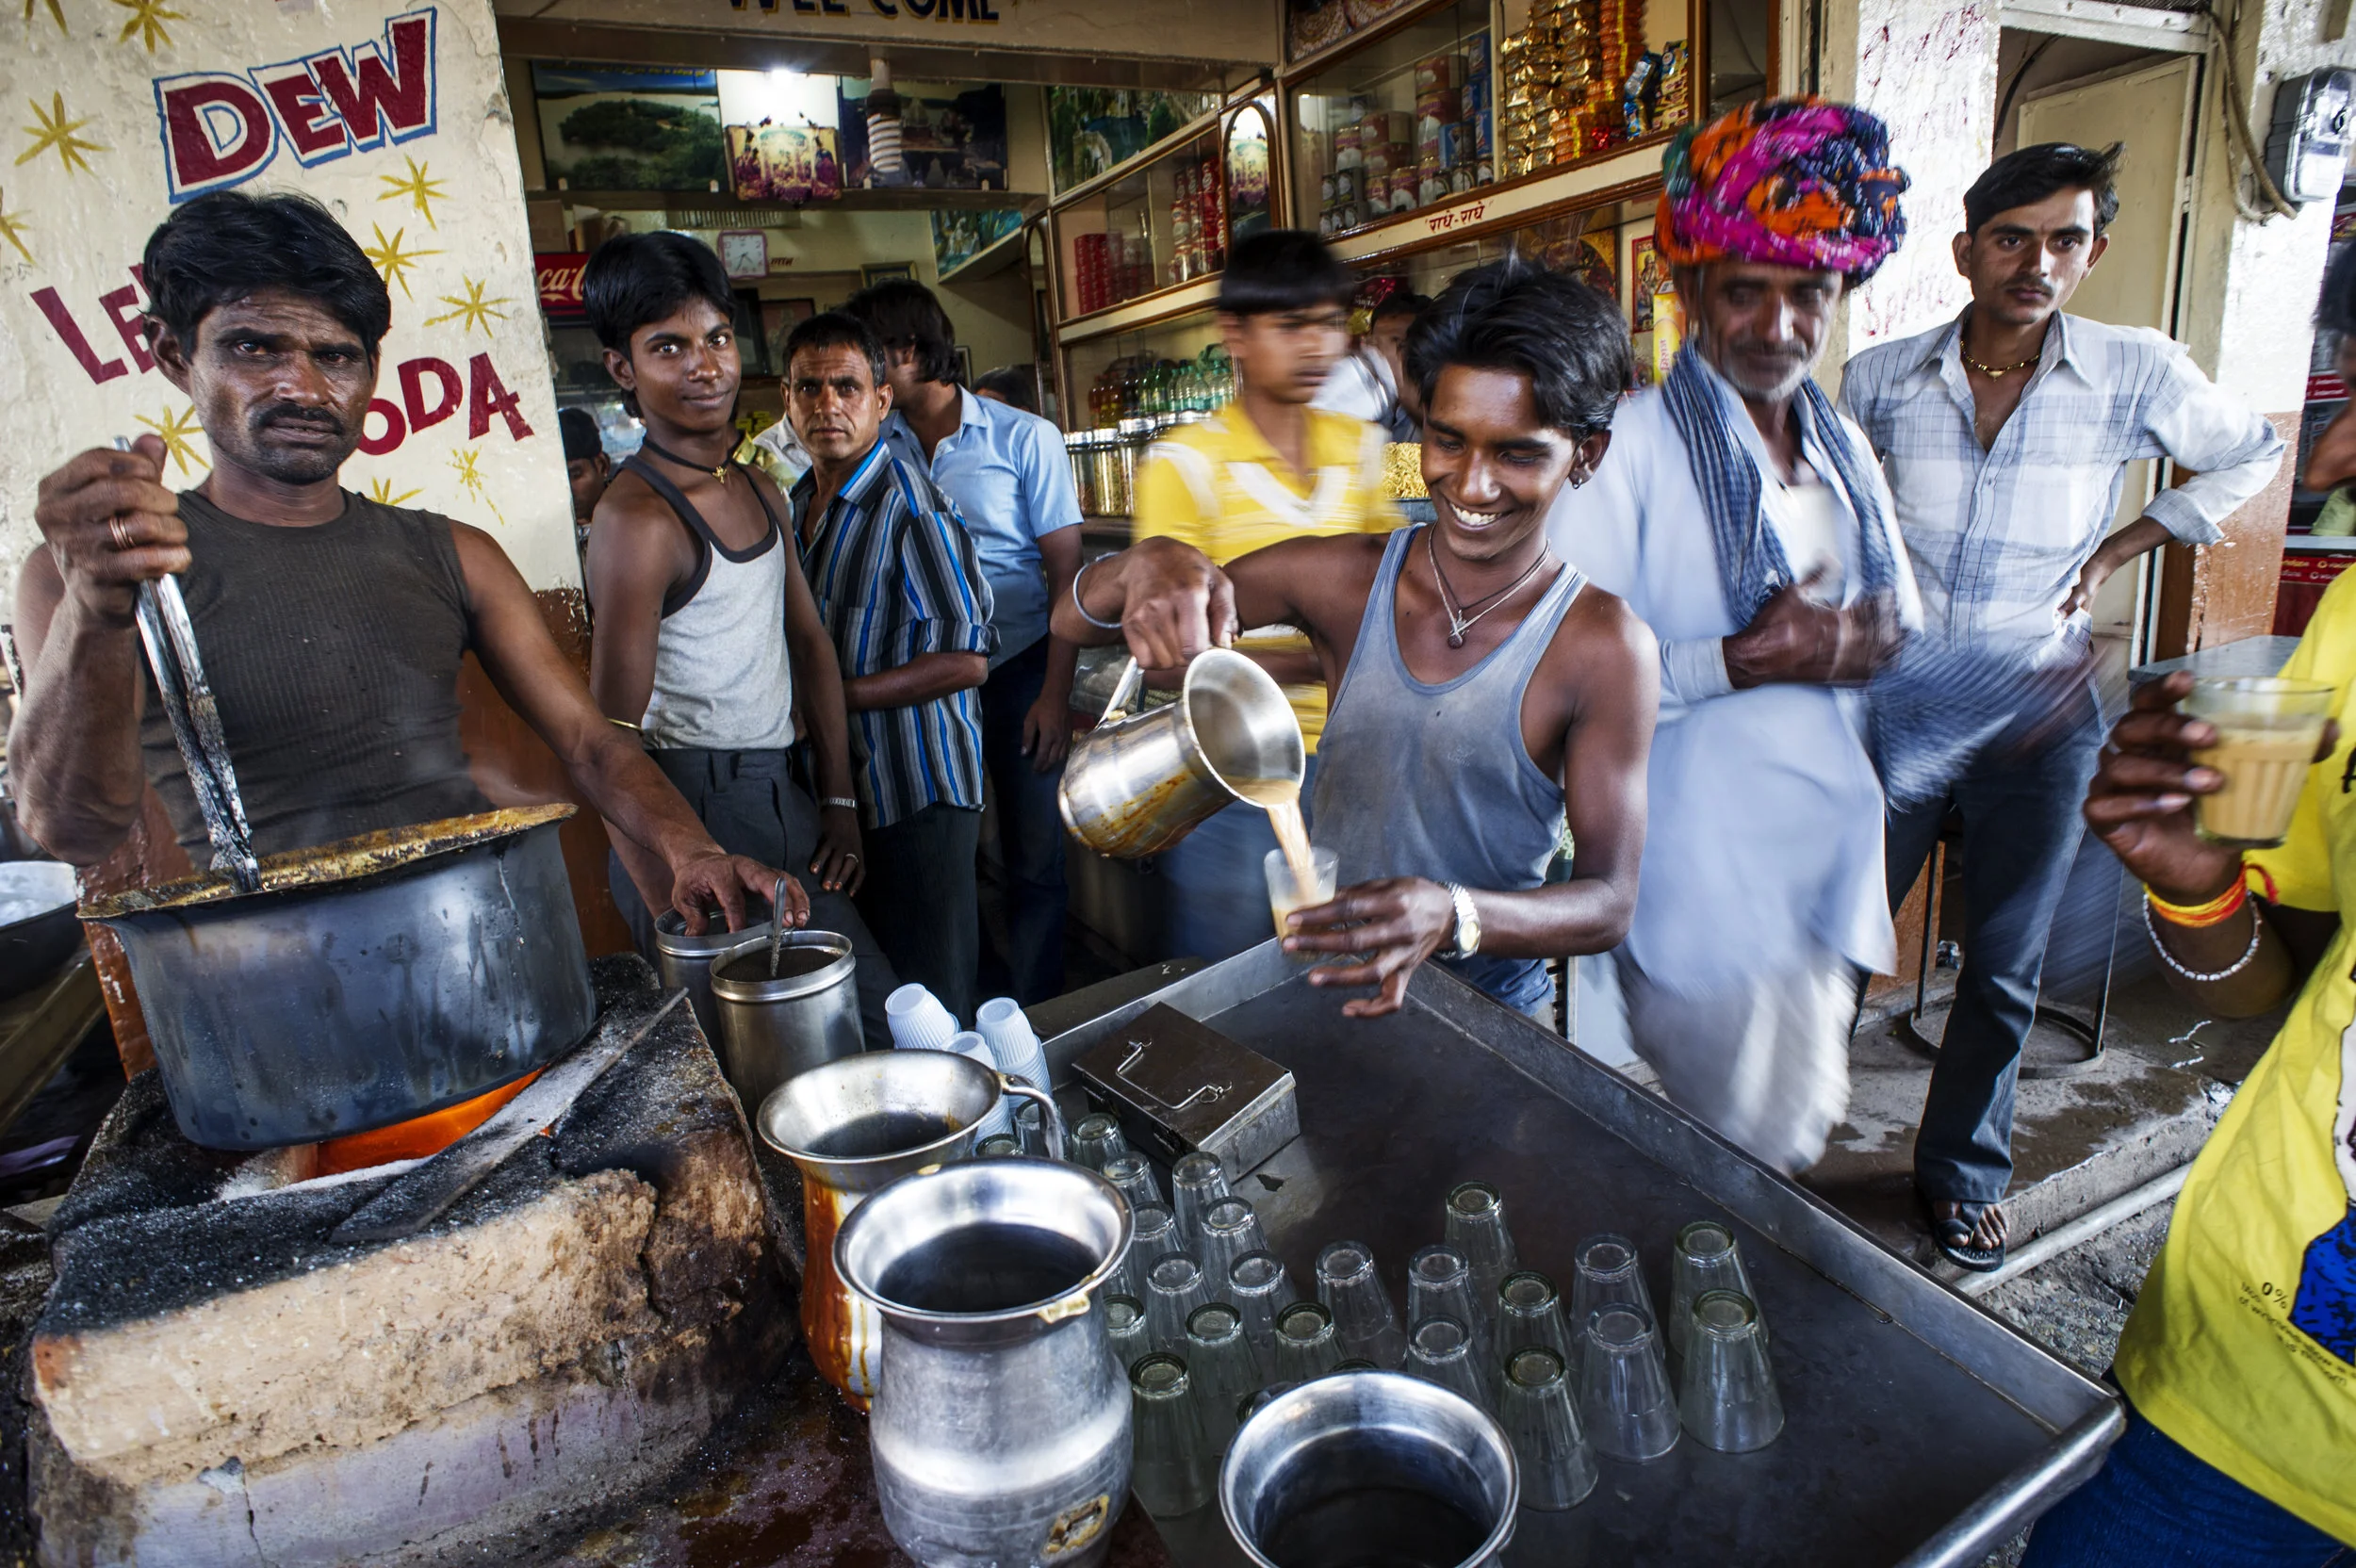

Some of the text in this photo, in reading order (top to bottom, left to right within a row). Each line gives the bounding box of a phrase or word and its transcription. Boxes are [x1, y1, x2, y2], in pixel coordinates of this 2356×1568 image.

[153, 7, 437, 204] DEW
[30, 263, 156, 384] LE
[357, 351, 535, 442] ODA
